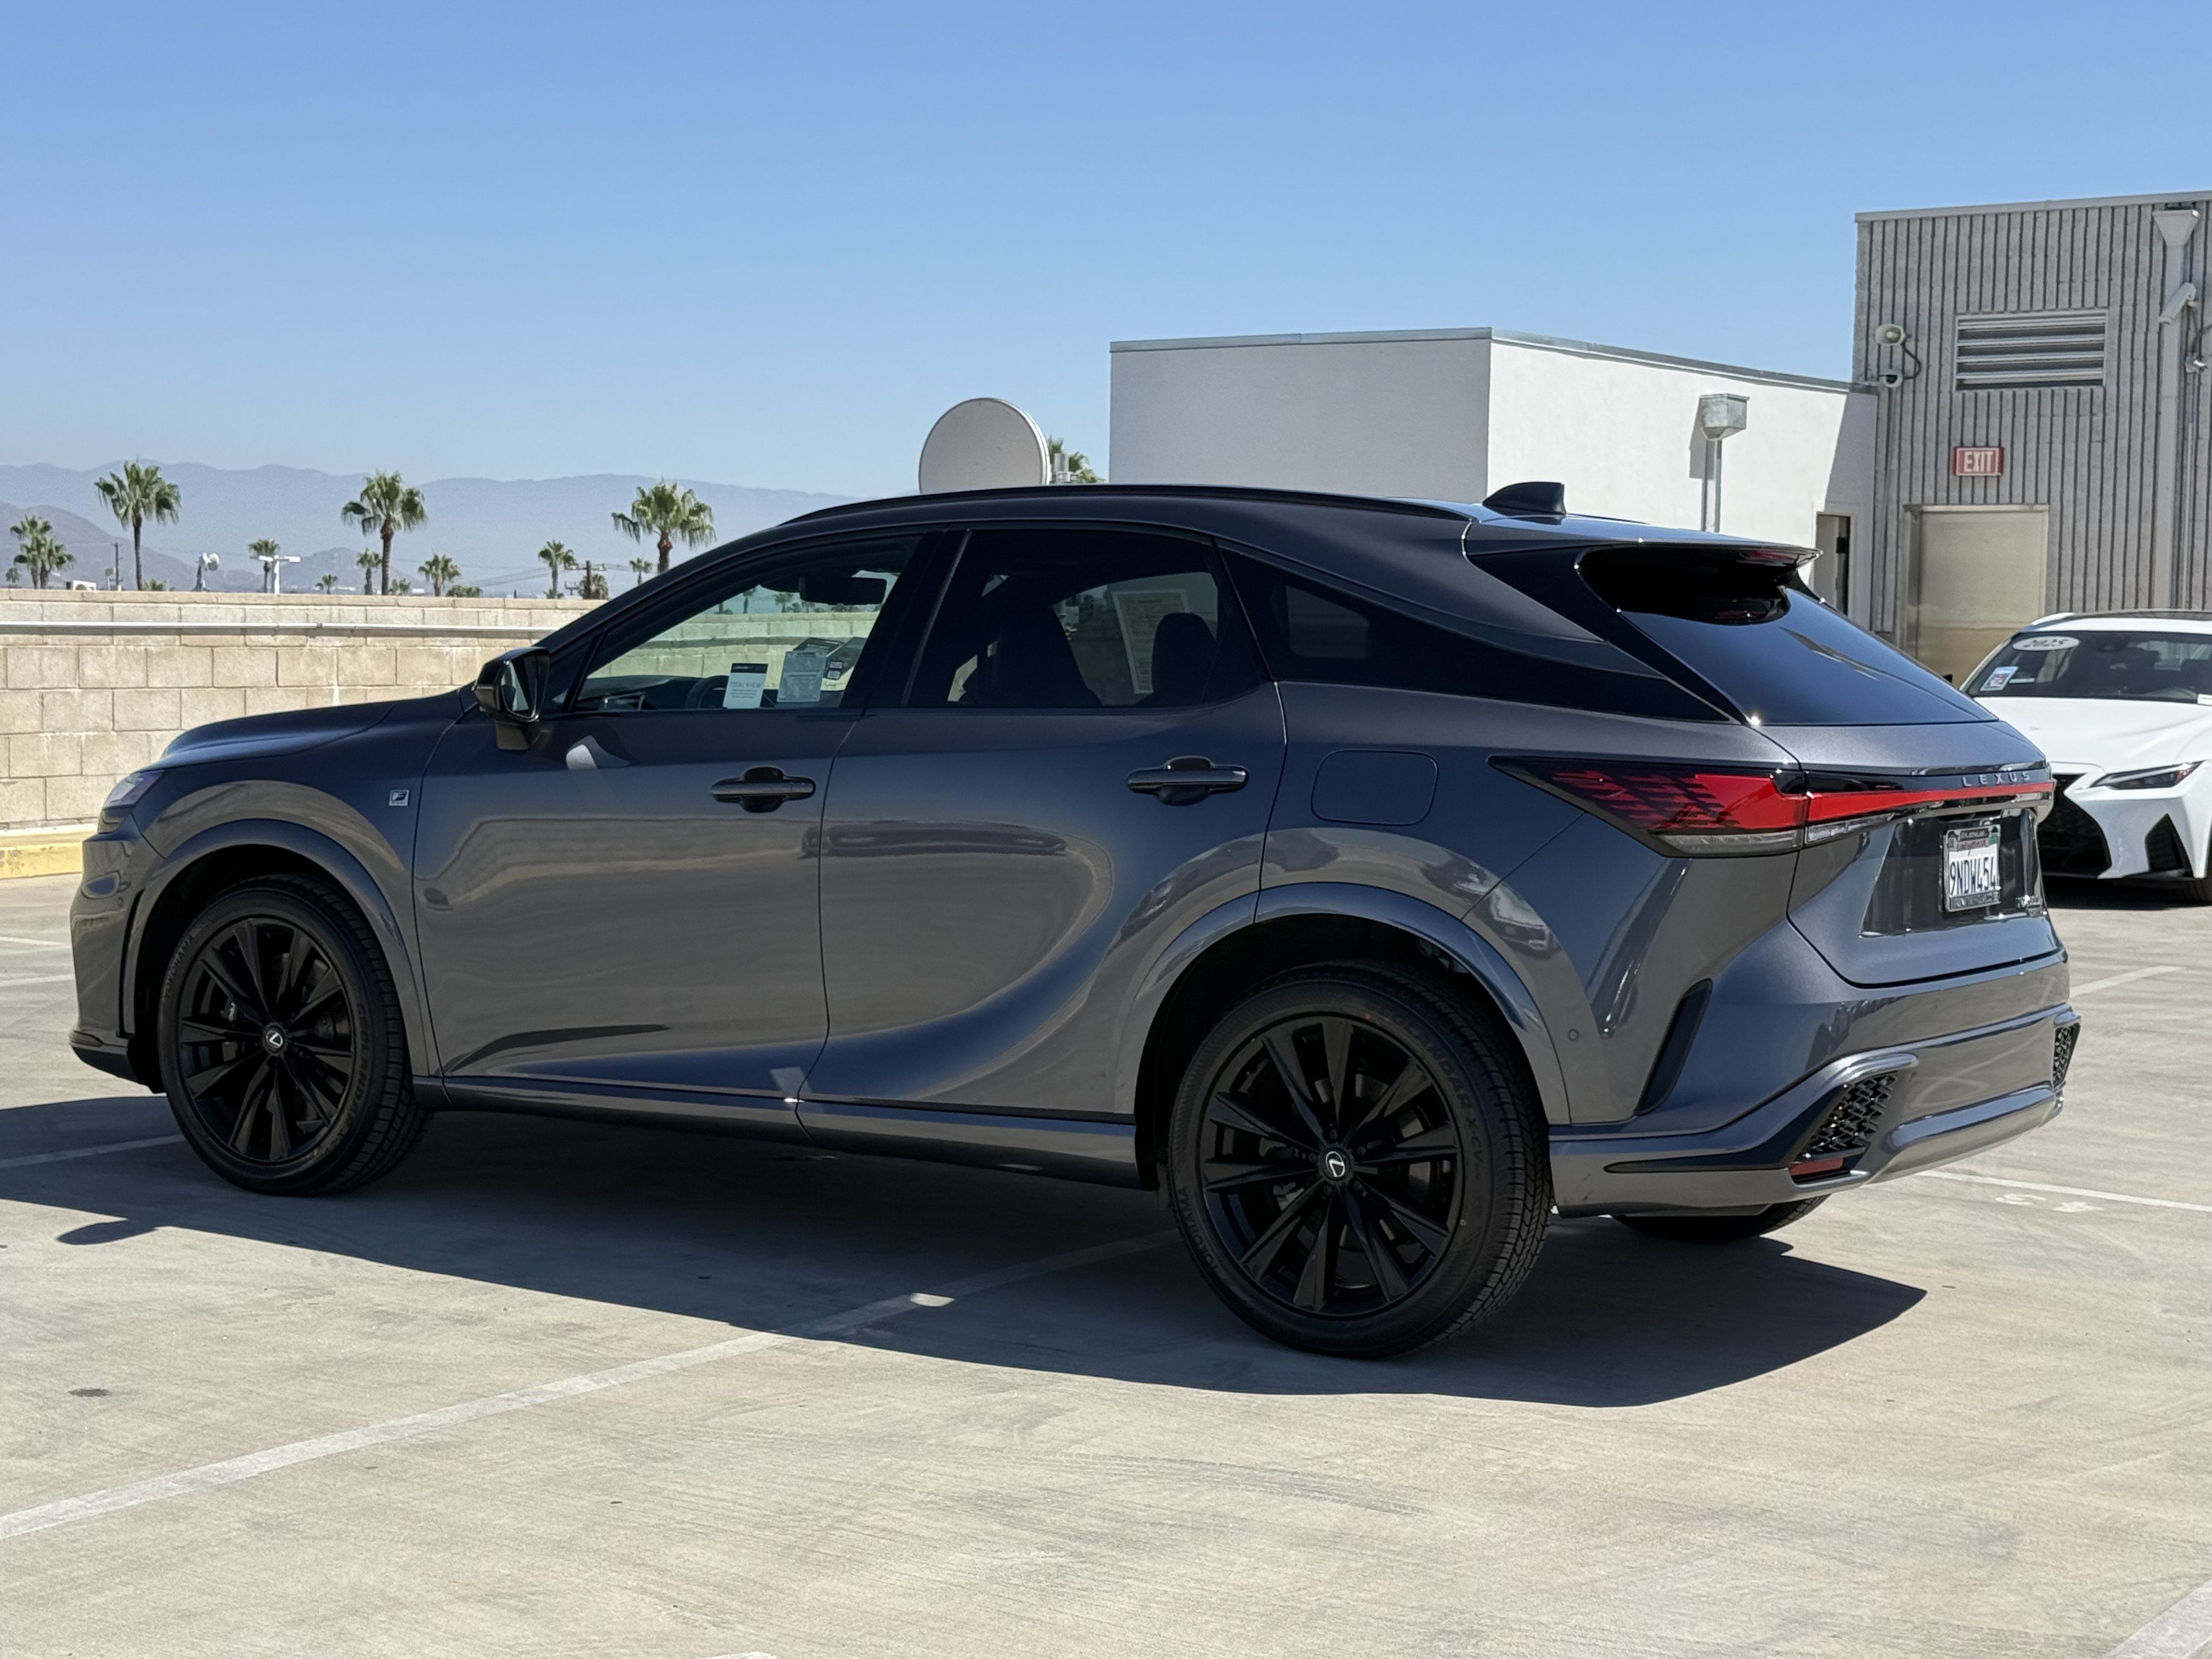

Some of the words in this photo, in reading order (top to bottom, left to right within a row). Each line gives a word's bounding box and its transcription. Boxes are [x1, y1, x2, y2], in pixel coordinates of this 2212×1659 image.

[1964, 451, 1994, 472] EXIT
[2023, 639, 2069, 647] 2025
[1961, 771, 2030, 787] LEXUS
[1950, 856, 1996, 896] 9NDW454
[164, 934, 195, 999] YOKOHAMA
[1177, 1186, 1219, 1271] YOKOHAMA
